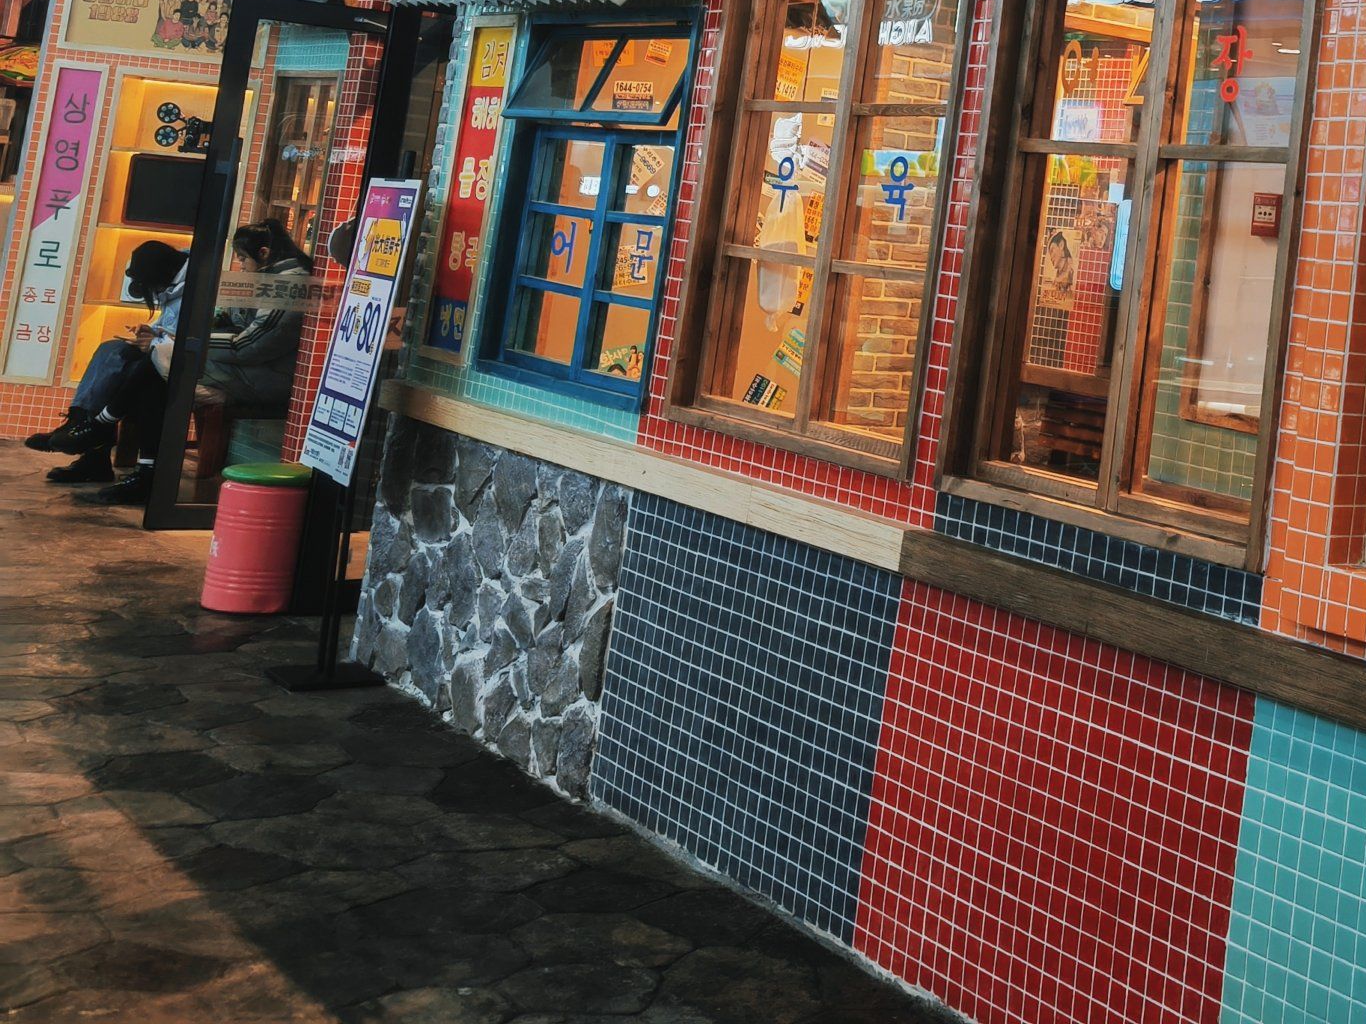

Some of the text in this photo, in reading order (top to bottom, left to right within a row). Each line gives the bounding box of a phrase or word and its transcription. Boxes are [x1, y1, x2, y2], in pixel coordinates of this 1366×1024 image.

[481, 41, 510, 79] 김치
[1211, 26, 1253, 103] 장
[772, 157, 799, 213] 우
[881, 156, 914, 221] 육
[551, 221, 576, 273] 어
[630, 230, 653, 281] 문
[22, 286, 56, 305] 종로
